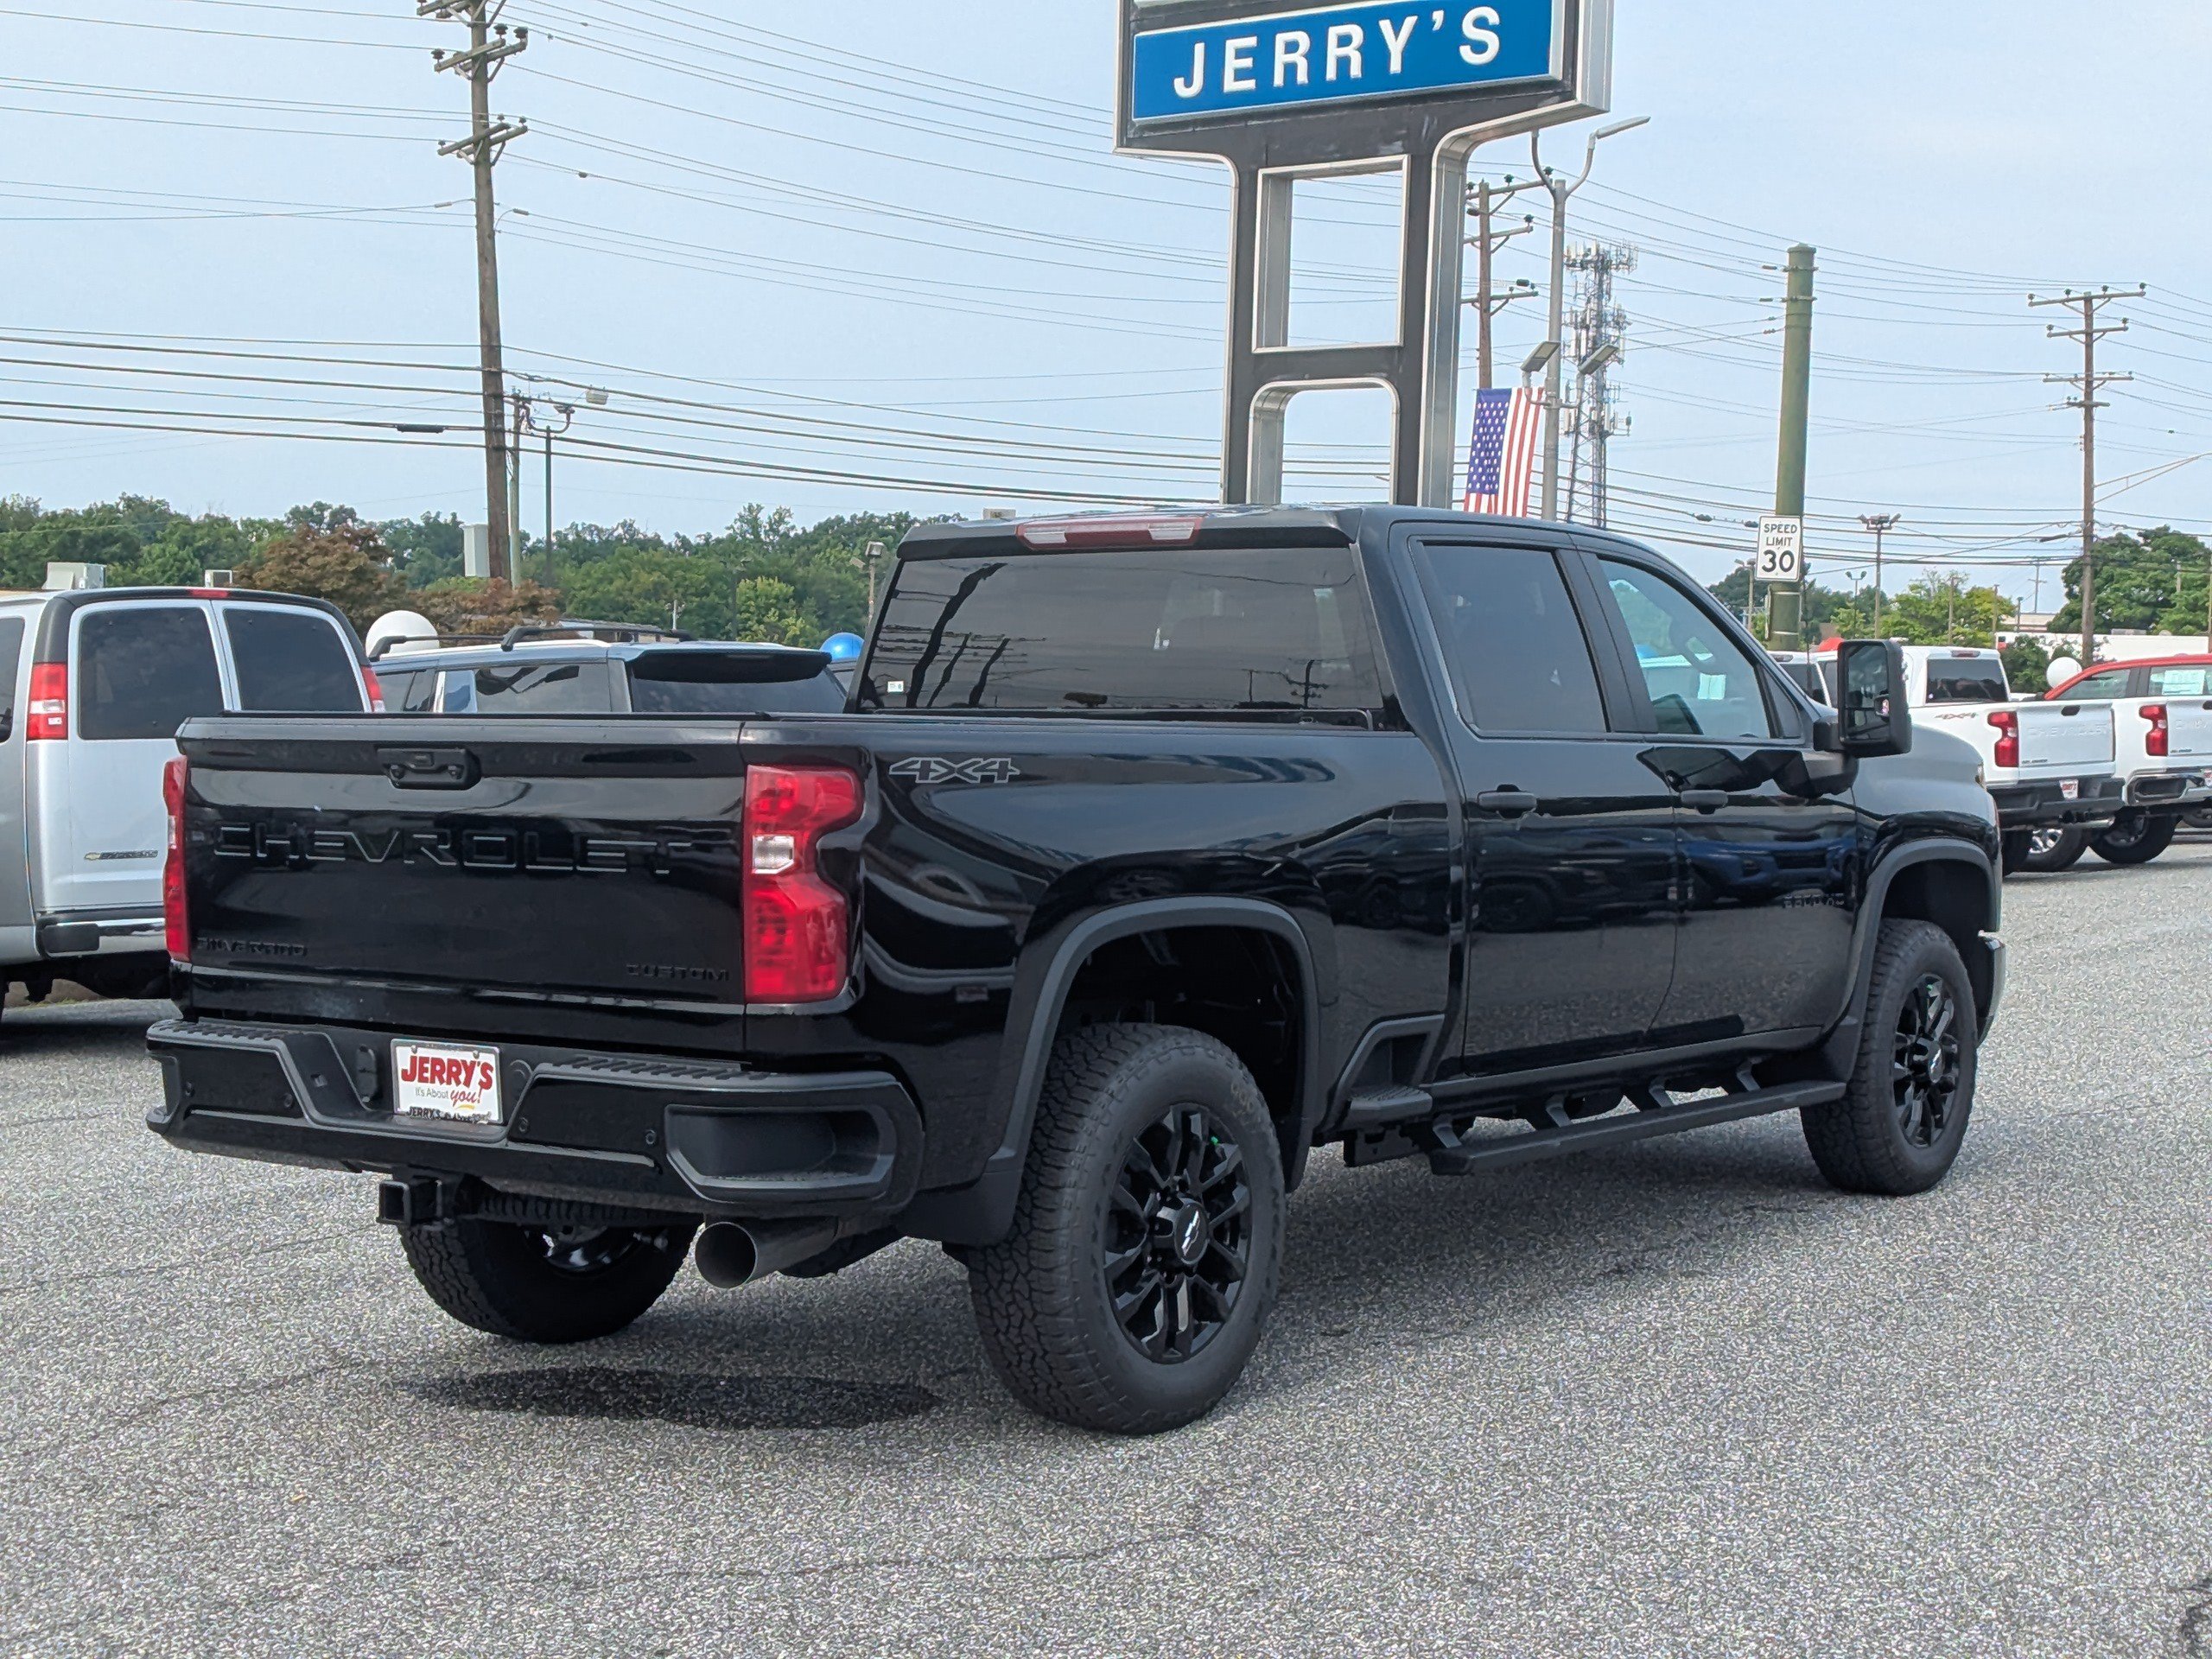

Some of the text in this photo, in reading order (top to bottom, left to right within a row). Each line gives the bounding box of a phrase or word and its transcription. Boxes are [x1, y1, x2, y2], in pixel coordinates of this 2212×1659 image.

[1173, 6, 1501, 99] JERRY'S
[1764, 524, 1797, 534] SPEED
[1766, 537, 1793, 546] LIMIT
[1761, 549, 1795, 573] 30
[888, 757, 1021, 784] 4X4
[401, 1055, 494, 1090] JERRY'S
[450, 1086, 482, 1107] you!
